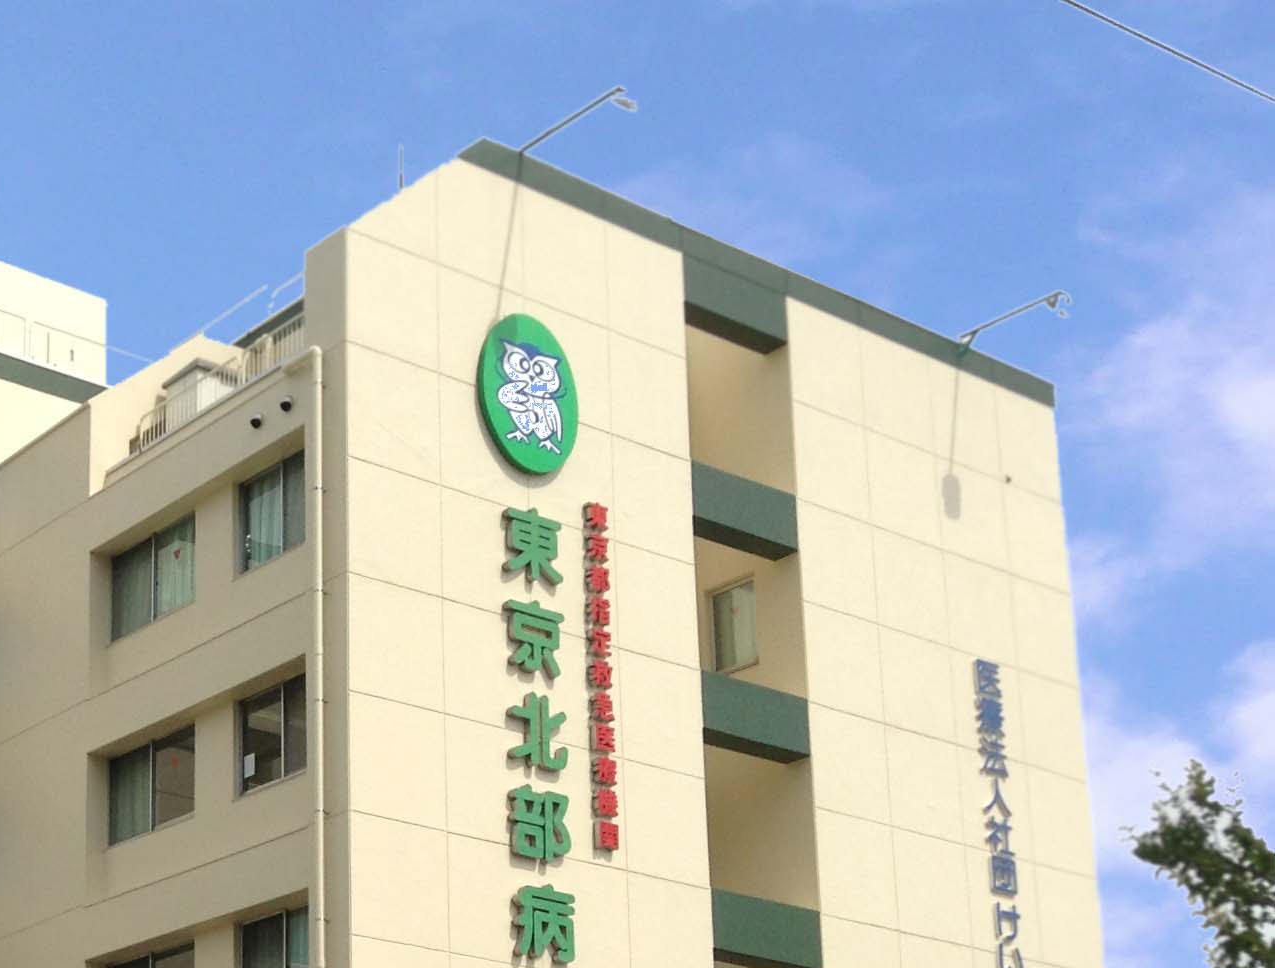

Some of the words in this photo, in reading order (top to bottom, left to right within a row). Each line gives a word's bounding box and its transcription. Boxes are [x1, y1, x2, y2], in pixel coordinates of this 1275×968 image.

[585, 503, 619, 851] 東京都指定救急医療機関
